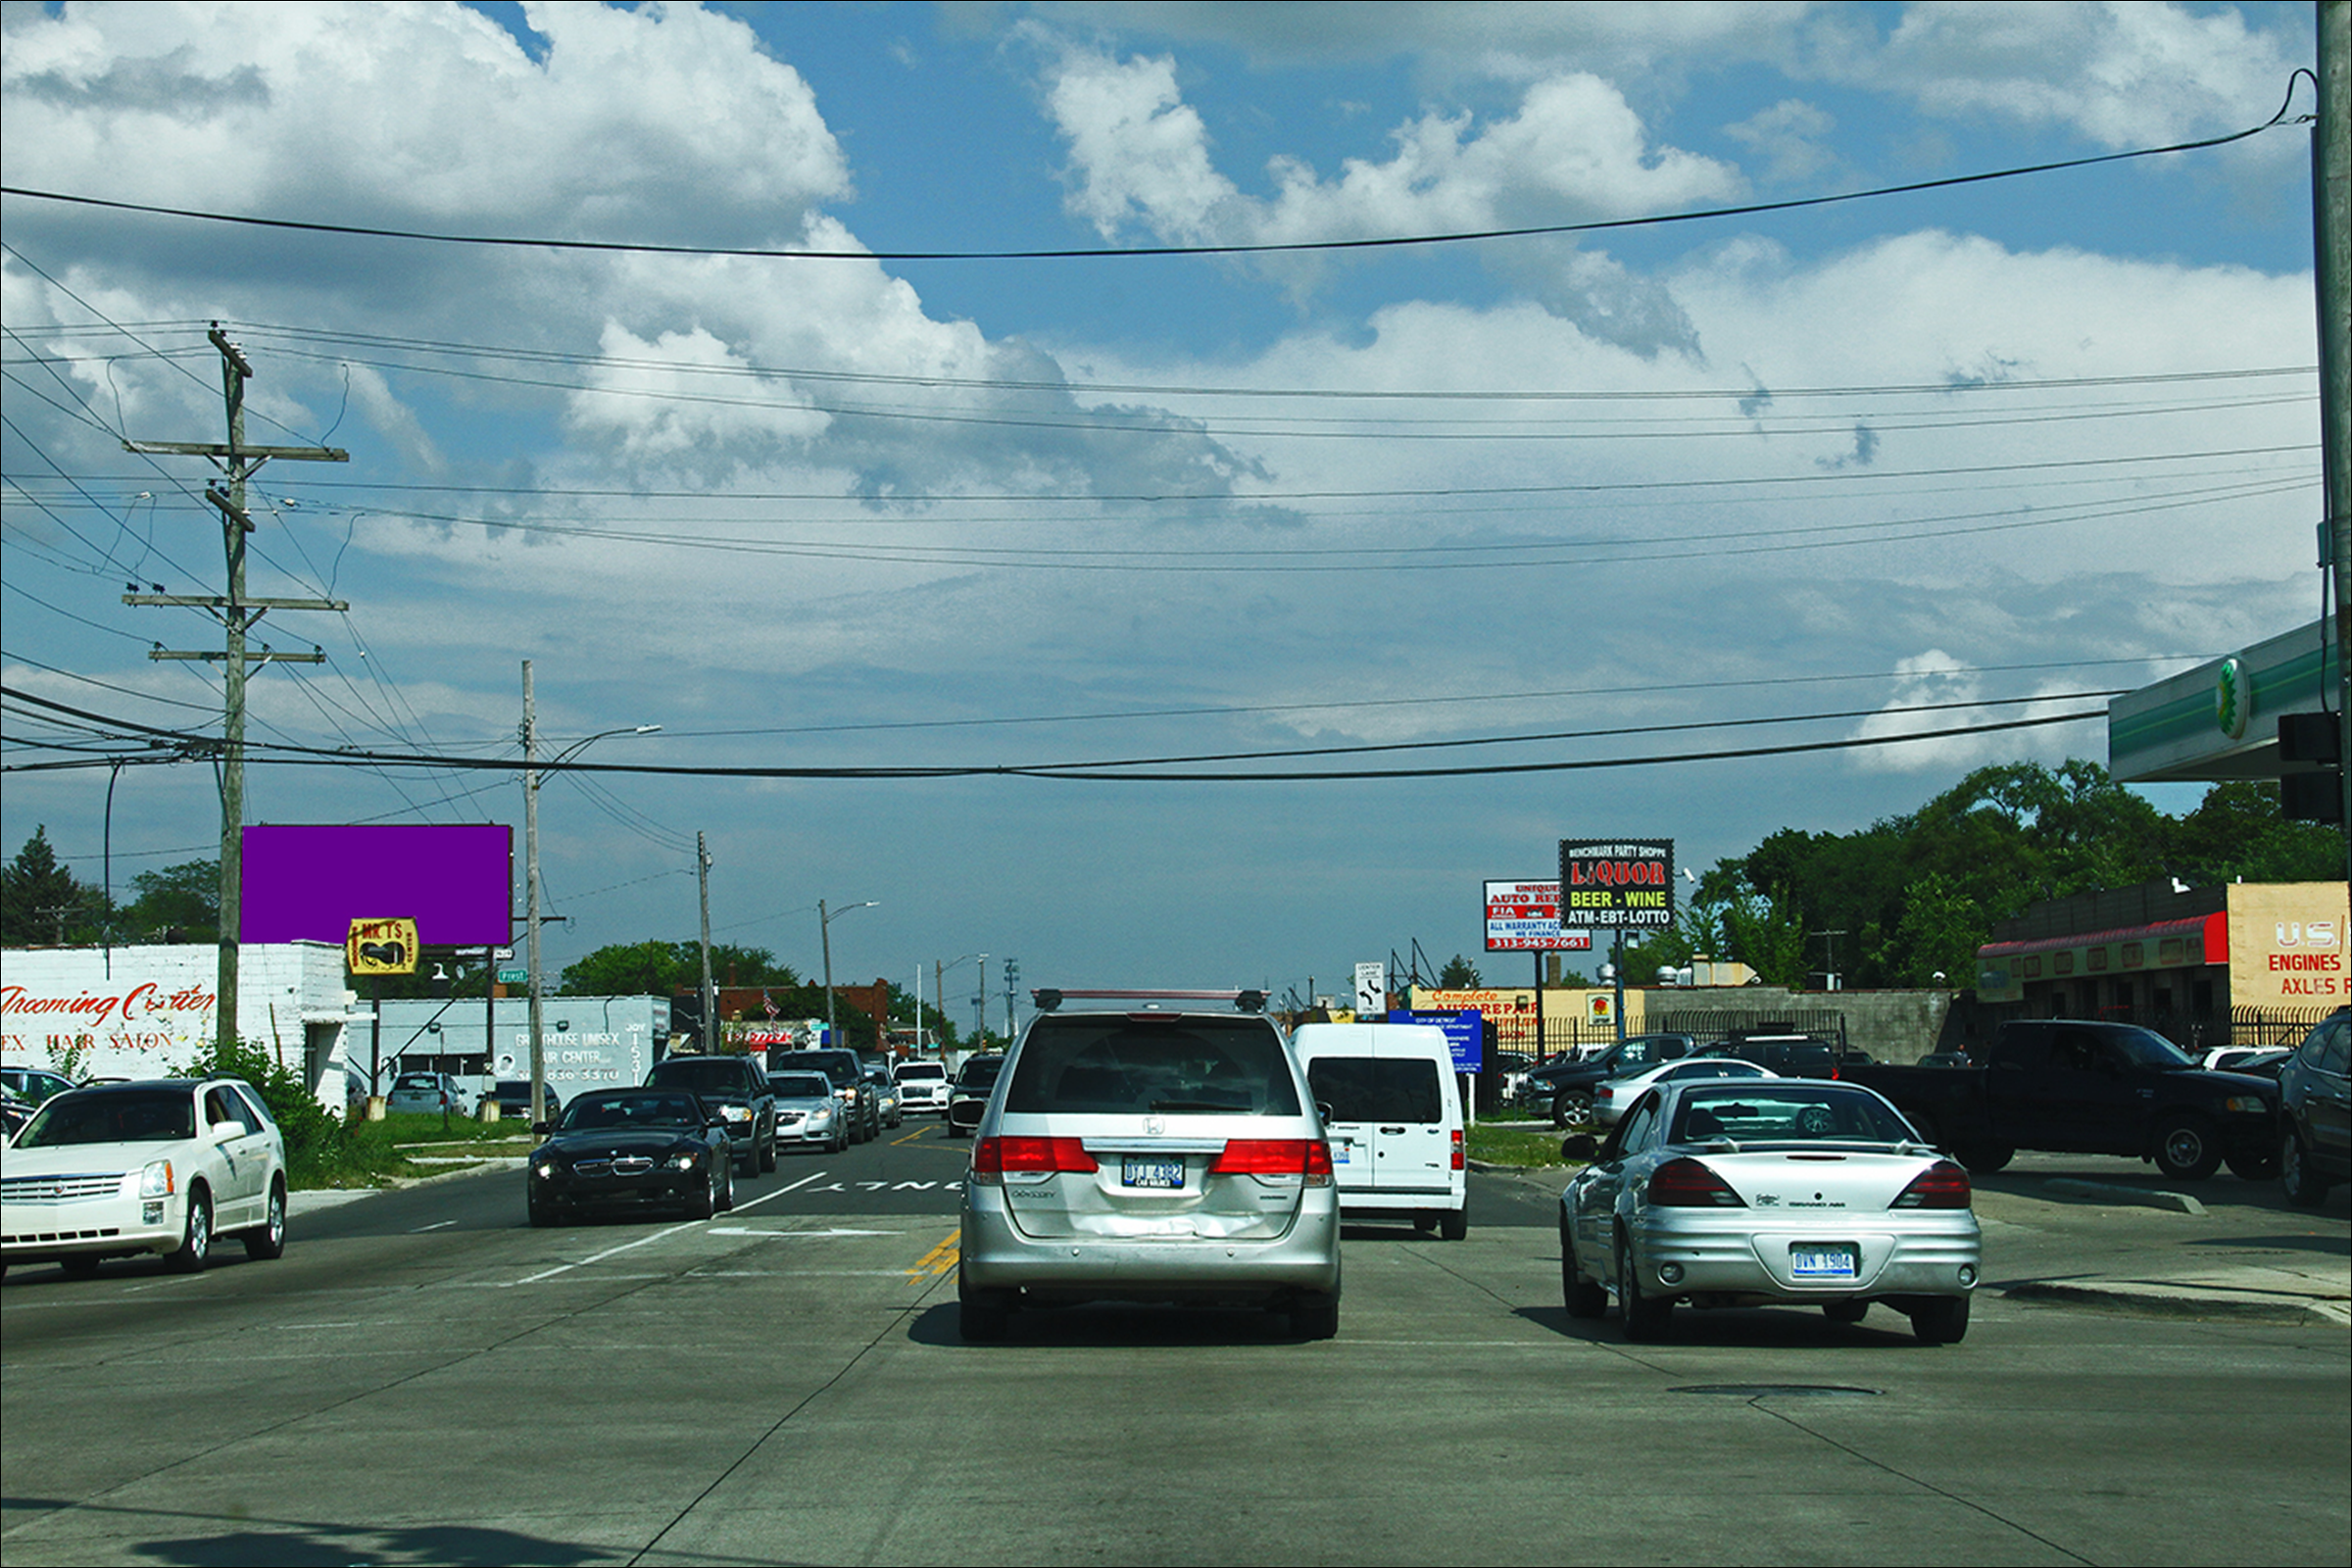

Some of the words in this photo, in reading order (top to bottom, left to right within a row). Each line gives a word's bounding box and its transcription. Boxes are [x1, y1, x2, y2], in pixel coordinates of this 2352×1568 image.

[1569, 845, 1613, 858] BENCHMARK
[1614, 845, 1638, 857] PARTY
[1639, 846, 1666, 858] SHOPPE
[1491, 894, 1530, 904] AUTO
[1535, 894, 1561, 904] REP
[1571, 891, 1612, 907] BEER
[1625, 891, 1666, 907] WINE
[1505, 921, 1546, 930] WARRANTY
[1494, 938, 1586, 949] 313-945-7661
[2268, 954, 2341, 971] ENGINES
[2281, 978, 2336, 995] AXLES
[1432, 990, 1497, 1005] Complete
[46, 1034, 97, 1052] HAIR
[582, 1032, 620, 1047] UNISEX
[542, 1051, 559, 1065] AIR
[562, 1050, 601, 1064] CENTER
[1822, 1252, 1849, 1268] 1904
